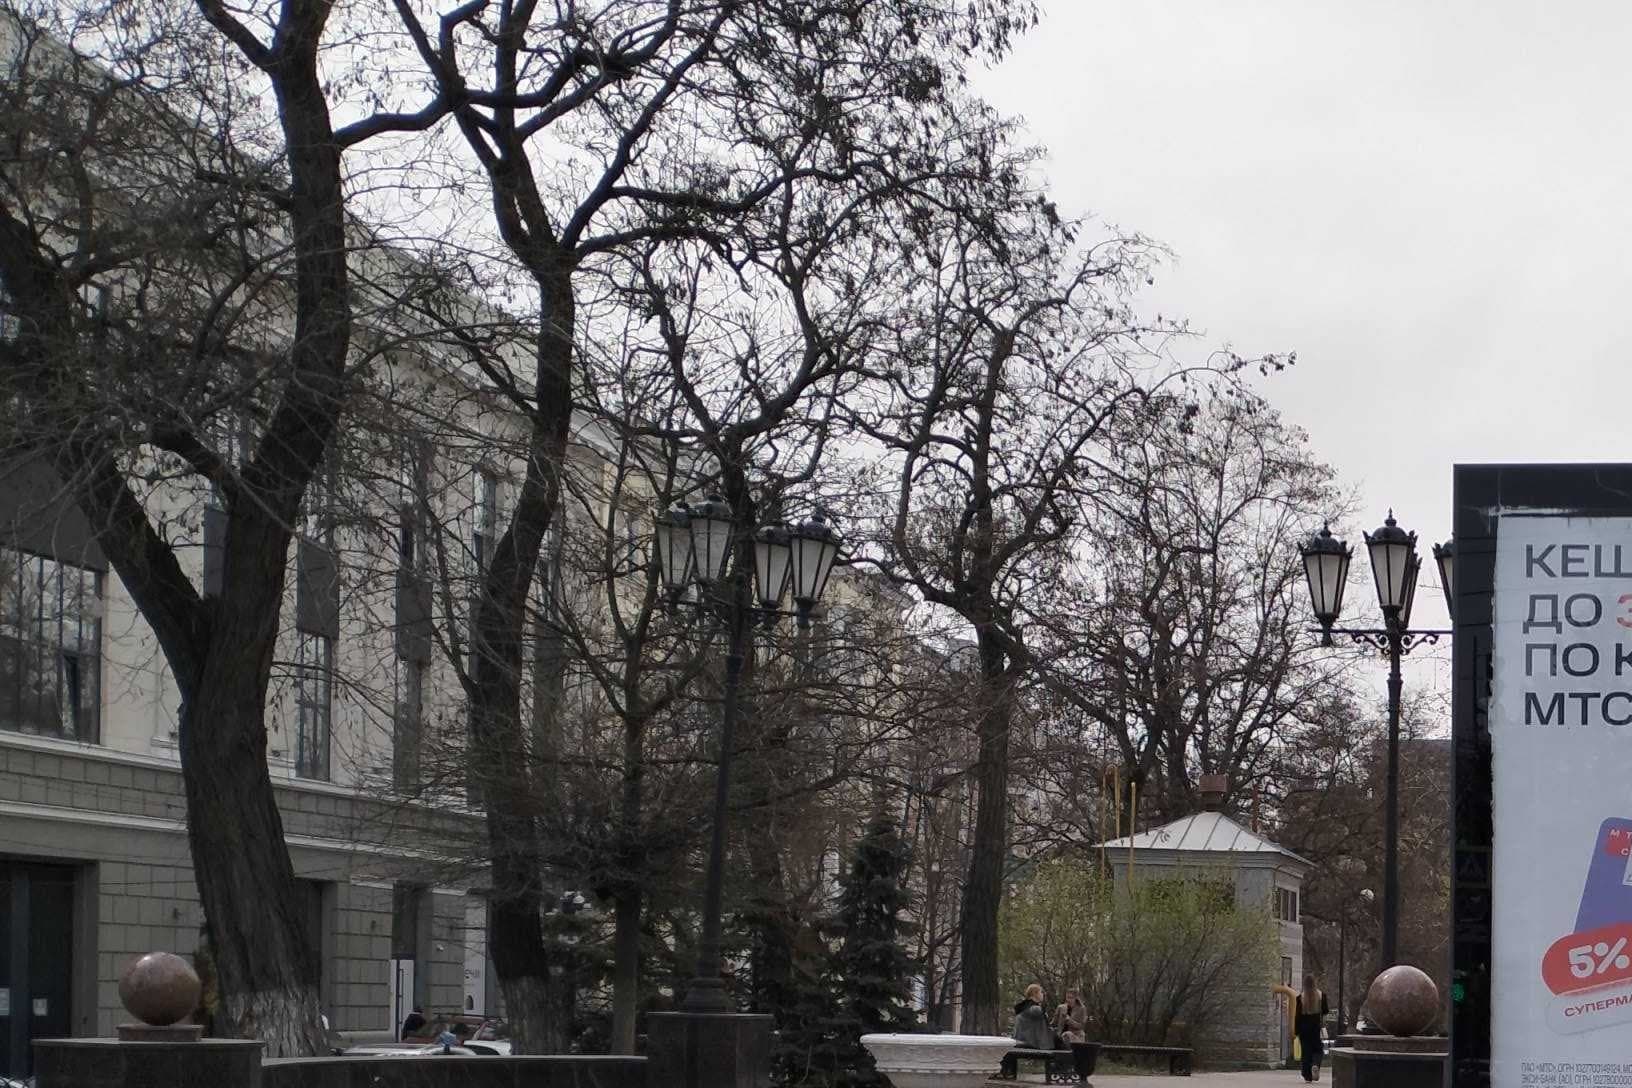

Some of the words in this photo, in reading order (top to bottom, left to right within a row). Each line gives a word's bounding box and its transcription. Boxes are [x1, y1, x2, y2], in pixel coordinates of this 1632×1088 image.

[1522, 592, 1603, 635] ДО
[1525, 642, 1600, 678] ПО
[1568, 936, 1631, 979] 5%
